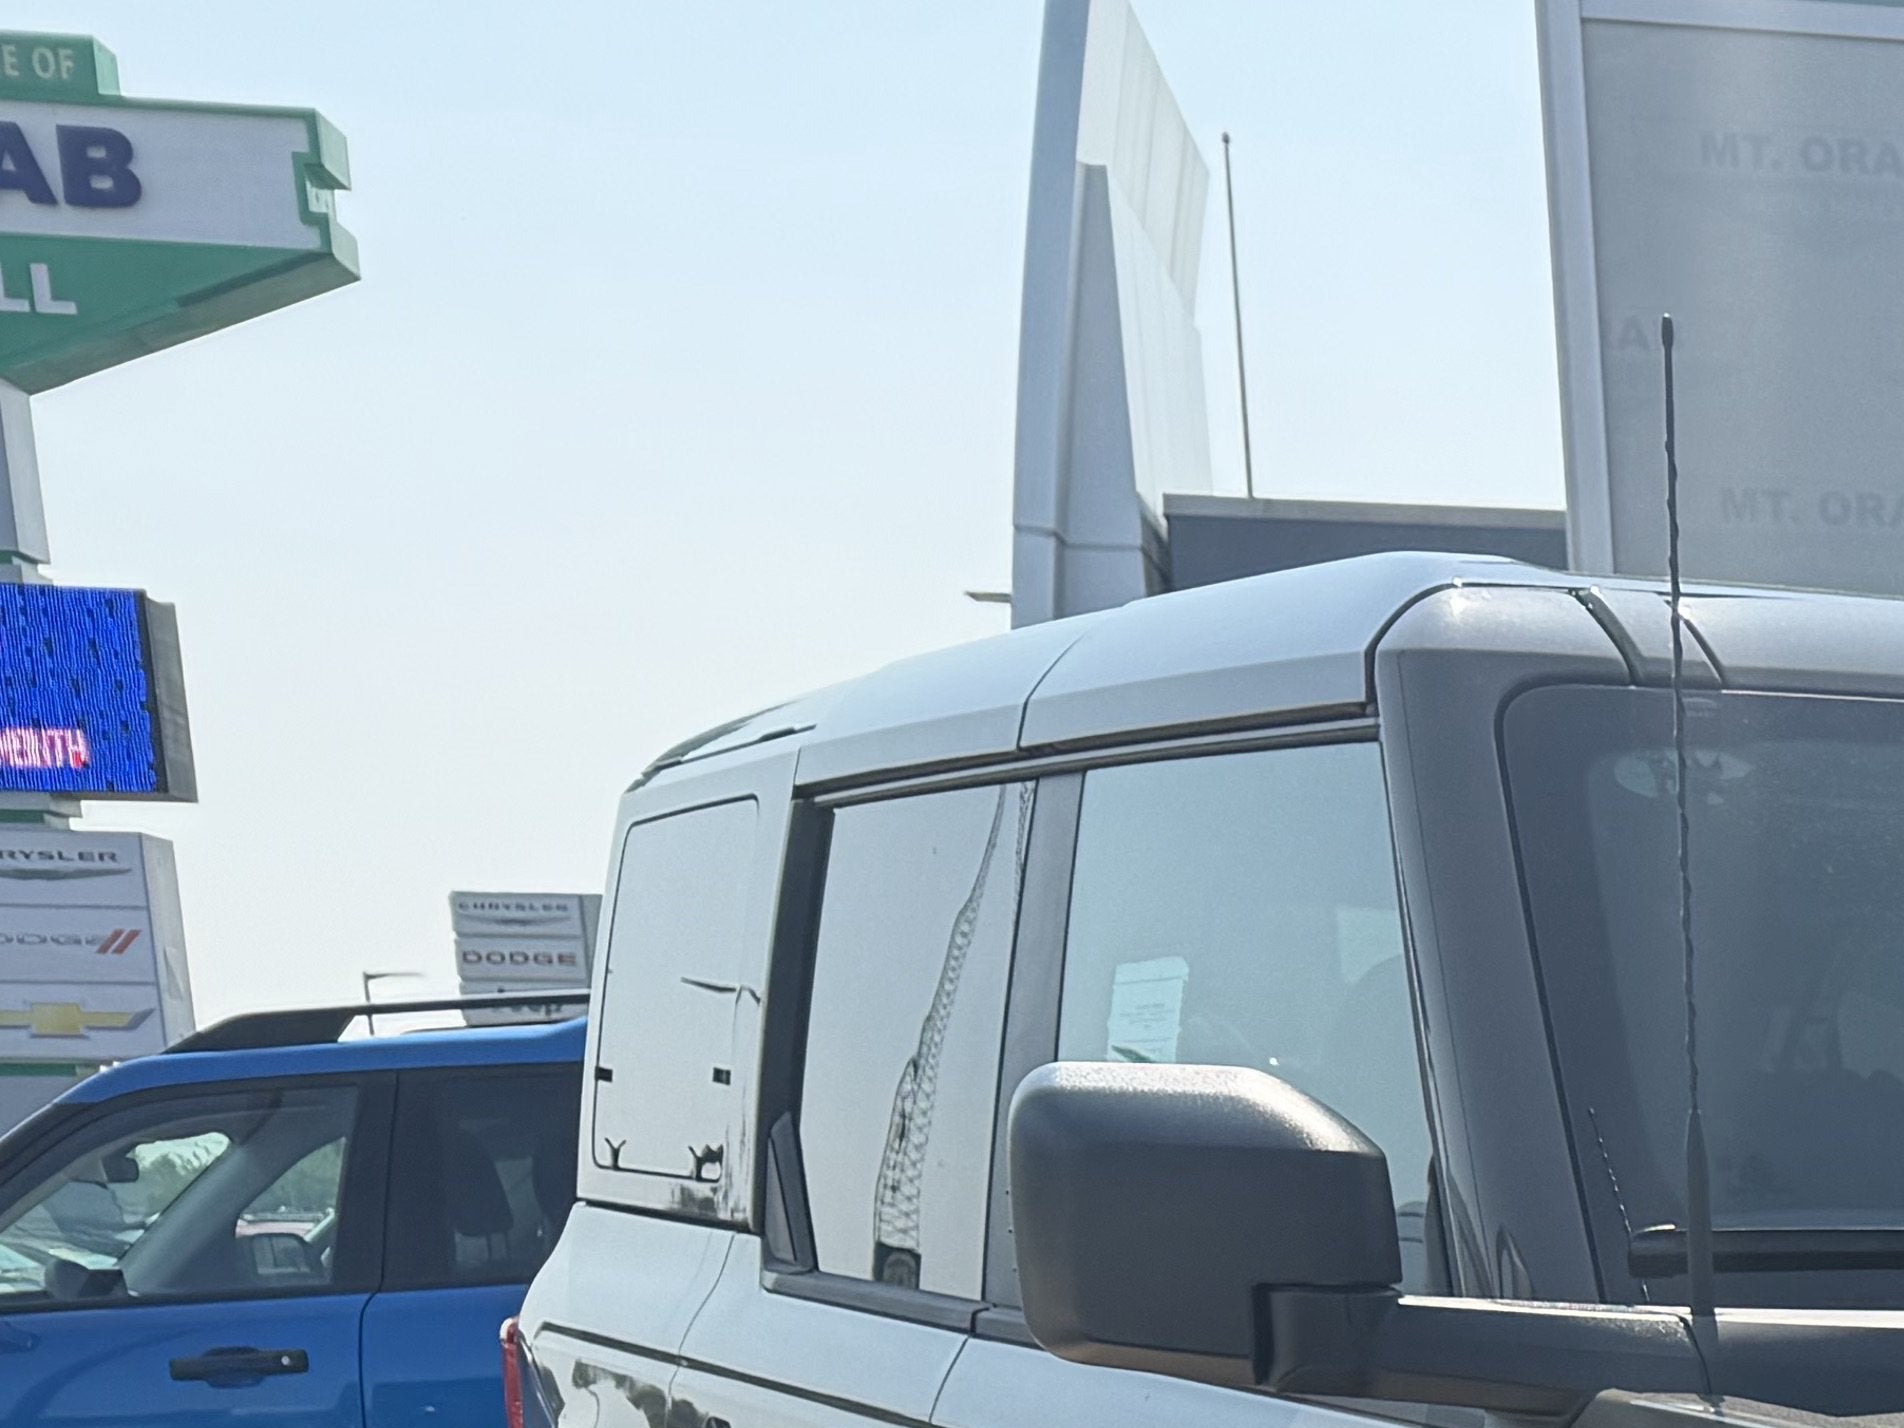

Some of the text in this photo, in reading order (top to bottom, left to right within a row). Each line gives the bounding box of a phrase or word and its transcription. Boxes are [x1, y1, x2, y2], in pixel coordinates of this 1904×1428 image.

[32, 47, 74, 79] OF
[0, 120, 142, 208] AB
[1699, 131, 1781, 172] MT.
[1720, 486, 1801, 526] MT.
[463, 950, 577, 965] DODGE
